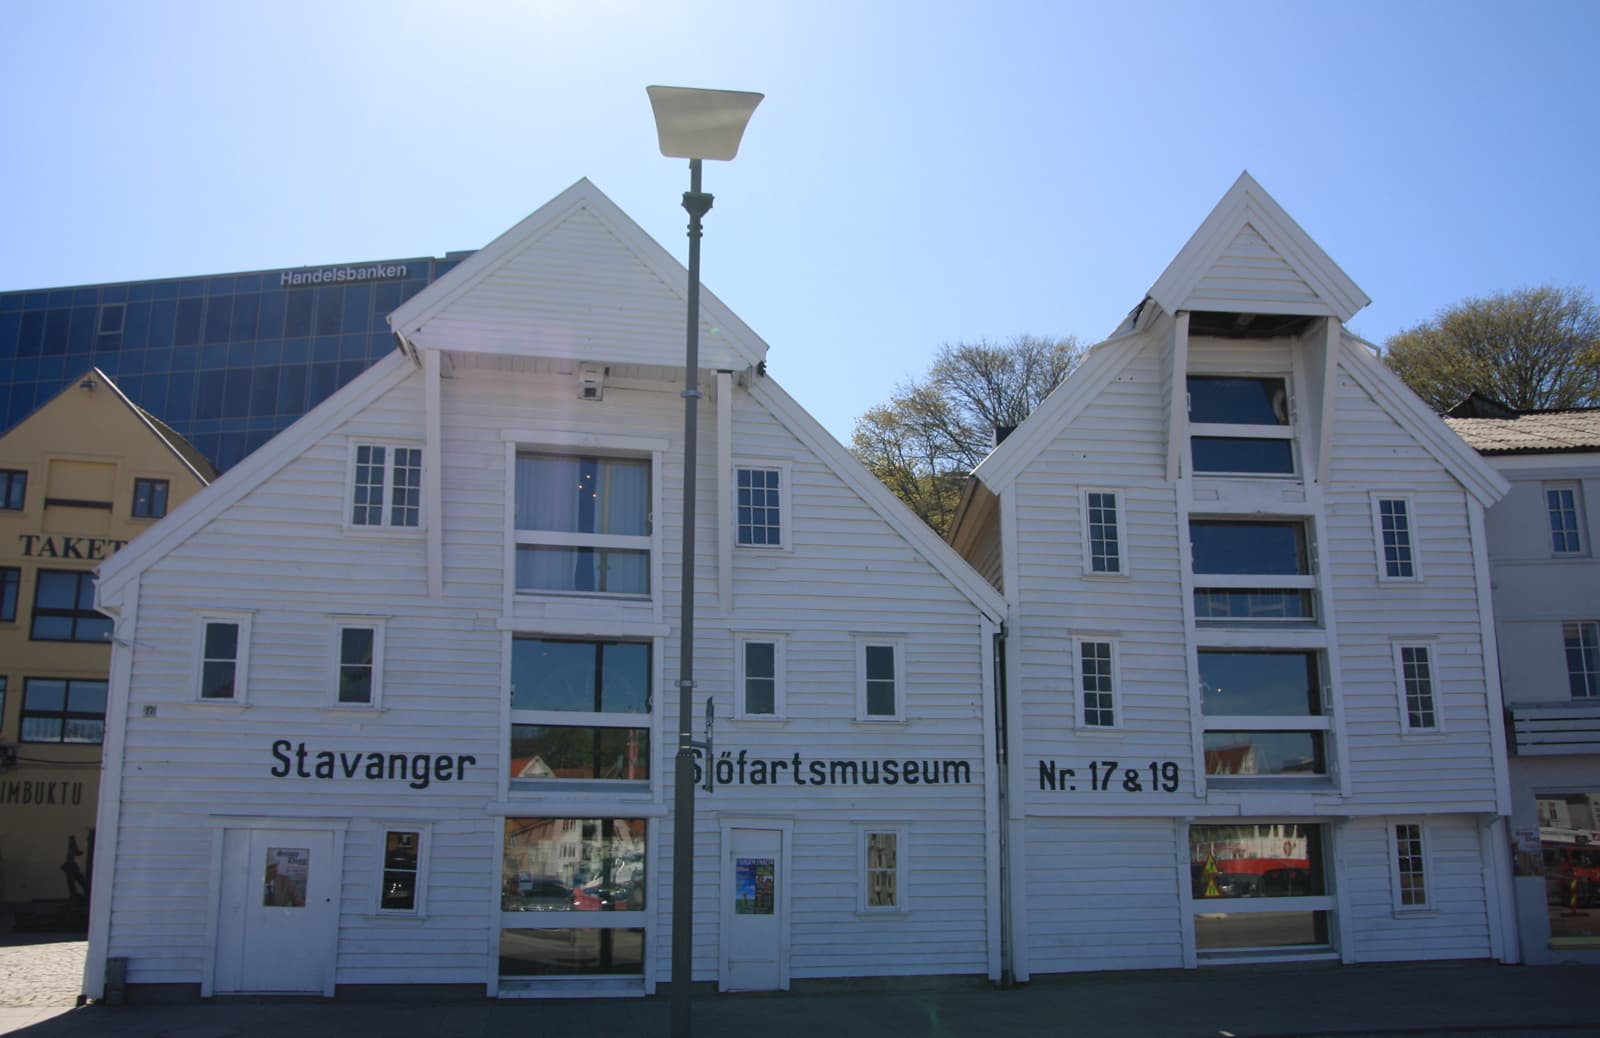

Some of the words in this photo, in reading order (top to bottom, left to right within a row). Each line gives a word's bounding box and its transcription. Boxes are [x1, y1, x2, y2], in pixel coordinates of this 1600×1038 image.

[280, 264, 407, 285] Handelsbanken
[19, 534, 129, 560] TAKET
[271, 740, 476, 789] Stavanger
[691, 748, 971, 793] Söfartsmuseum
[1039, 760, 1076, 791] Nr.
